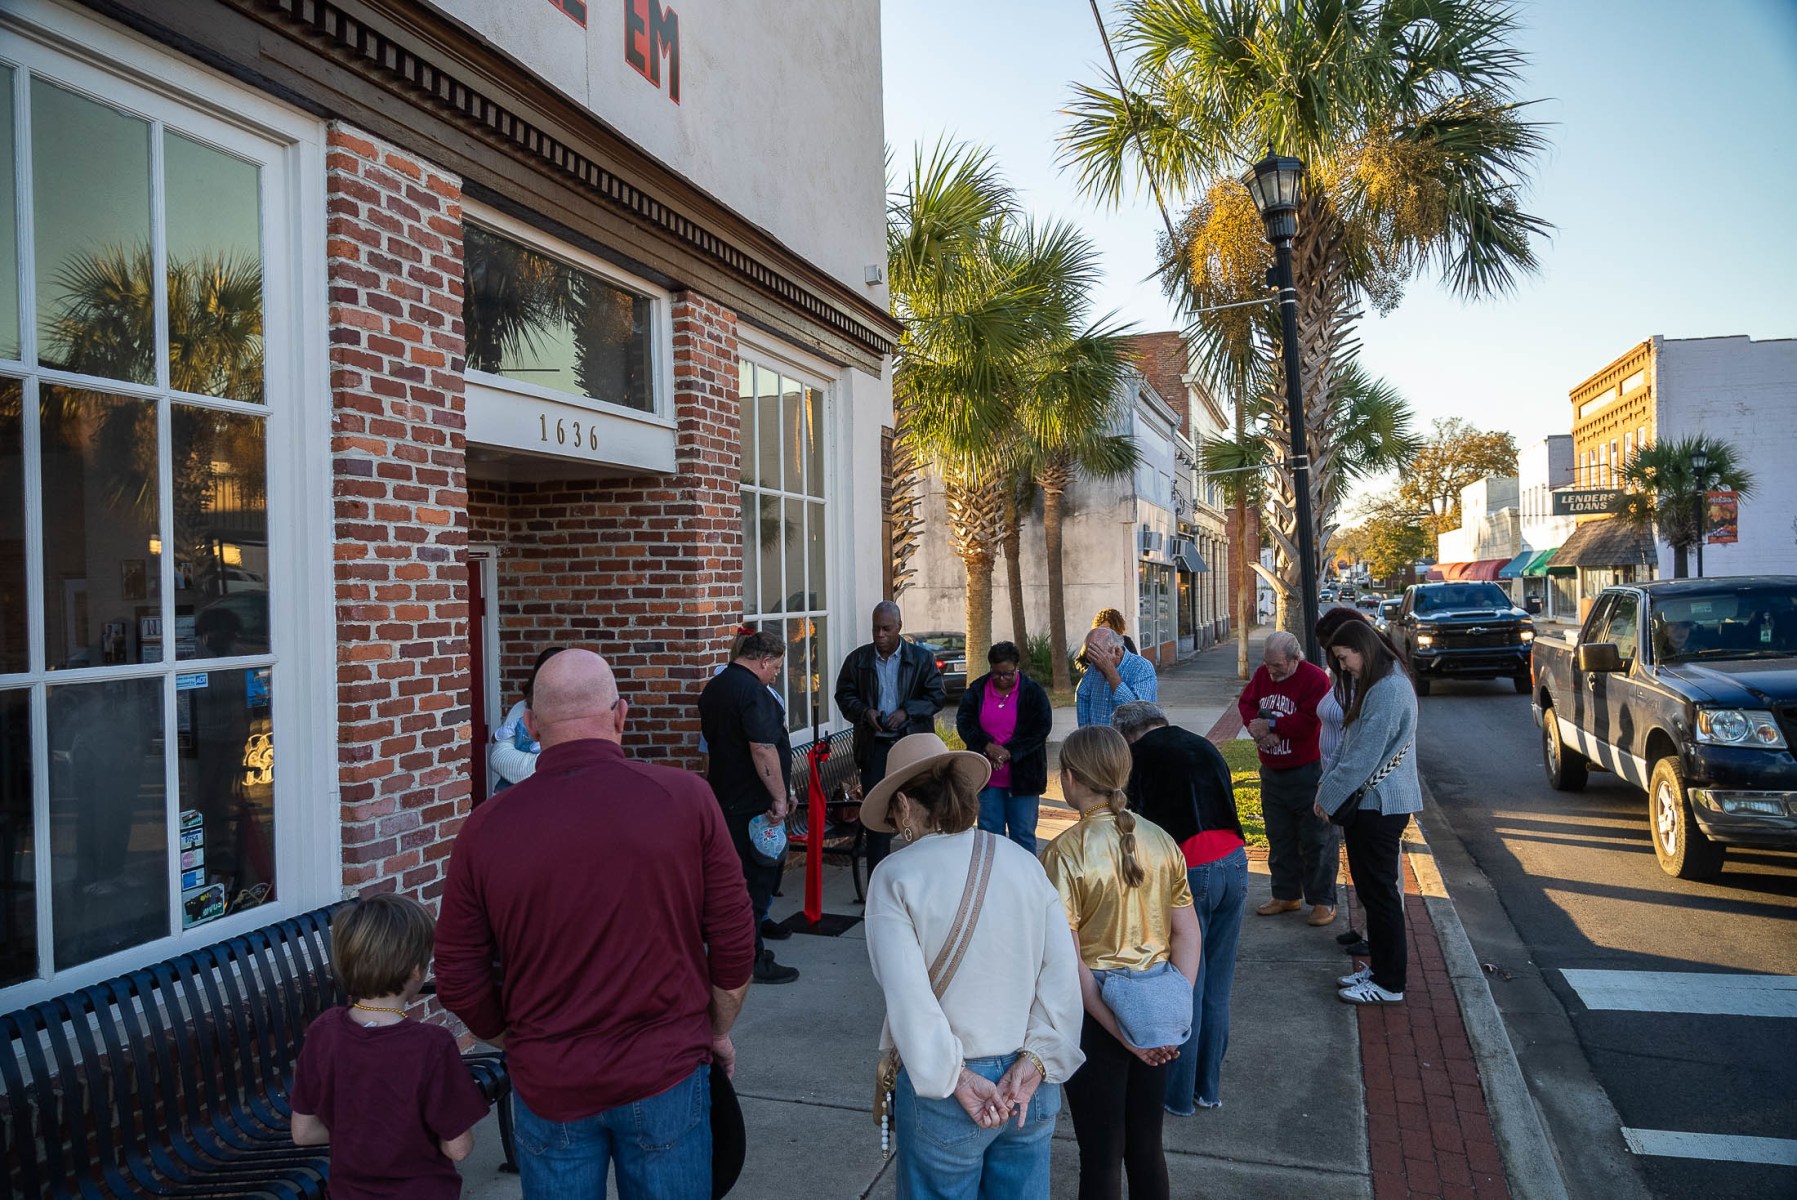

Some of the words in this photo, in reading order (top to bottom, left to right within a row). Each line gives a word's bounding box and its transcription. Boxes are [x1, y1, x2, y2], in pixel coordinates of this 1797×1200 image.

[540, 413, 598, 451] 1636
[1561, 493, 1616, 504] LENDERS
[1569, 501, 1608, 511] LOANS
